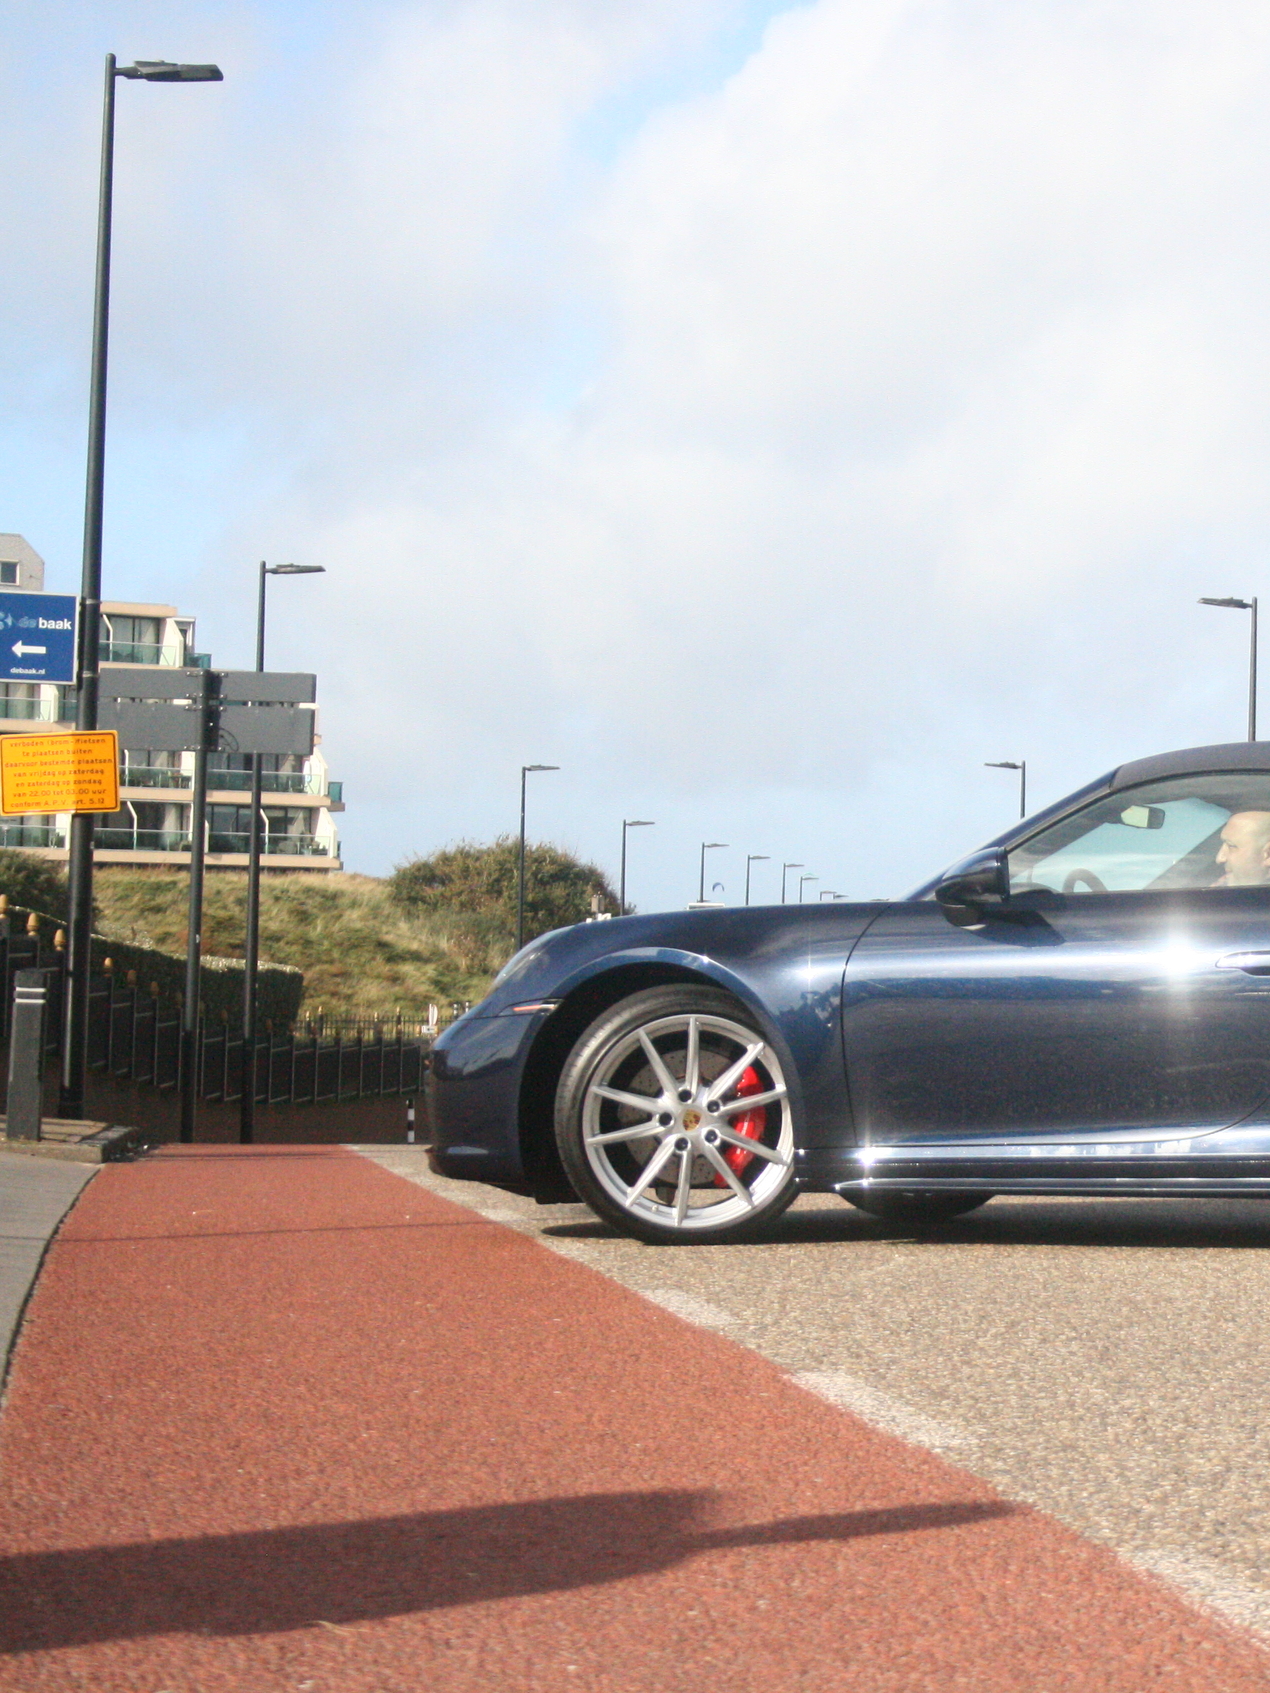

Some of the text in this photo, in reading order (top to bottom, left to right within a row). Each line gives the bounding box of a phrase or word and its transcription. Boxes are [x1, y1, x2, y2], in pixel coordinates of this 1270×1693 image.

[38, 617, 72, 630] baak
[10, 667, 46, 675] debaak.nl
[10, 740, 44, 748] verboden
[32, 749, 65, 758] plaatsen
[77, 758, 113, 766] plaatsen
[29, 769, 56, 778] vrijdag
[69, 768, 105, 776] zaterdag
[27, 780, 60, 788] zaterdag
[73, 778, 102, 786] zondag
[10, 800, 42, 808] conform
